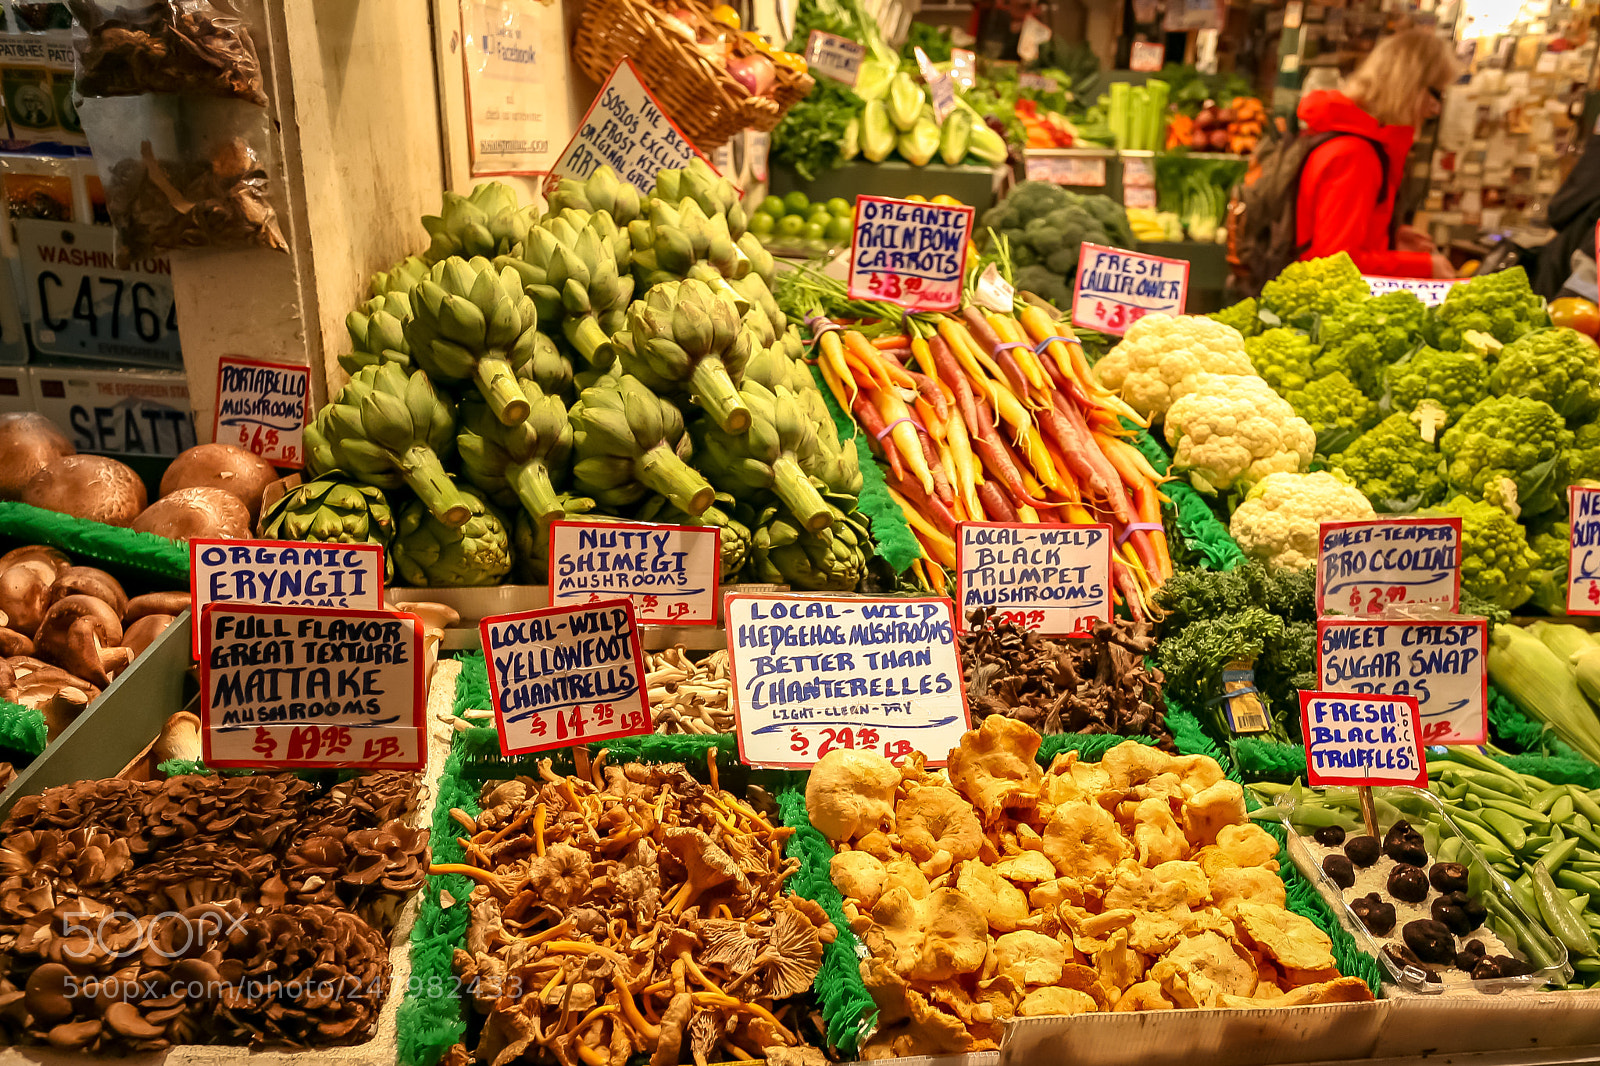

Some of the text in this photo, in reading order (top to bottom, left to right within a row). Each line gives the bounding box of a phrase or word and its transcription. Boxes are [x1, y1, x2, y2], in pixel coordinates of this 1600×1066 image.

[601, 119, 636, 155] FROST
[639, 96, 697, 160] THE BES
[580, 124, 625, 174] ORIGINAL
[639, 132, 686, 170] EXCLU
[864, 201, 965, 229] ORGANIC
[857, 222, 962, 252] RAINBOW
[857, 250, 959, 274] CARROTS
[1096, 253, 1163, 277] FRESH
[221, 365, 306, 398] PORTABELLO
[220, 398, 304, 420] MUSHROOMS
[201, 546, 363, 567] ORGANIC
[579, 529, 671, 555] NUTTY
[558, 552, 689, 576] SHIMEGI
[975, 547, 1061, 569] BLACK
[1323, 545, 1459, 586] BROCCOLINI
[210, 568, 367, 602] ERYNGII
[559, 572, 688, 590] MUSHROOMS
[963, 565, 1091, 588] TRUMPET
[964, 584, 1103, 606] MUSHROOMS
[215, 616, 402, 643] FULL FLAVOR
[739, 624, 846, 655] HEDGEHOG
[849, 620, 954, 645] MUSHROOMS
[1323, 626, 1477, 655] SWEET CRISP
[210, 640, 408, 669] GREAT TEXTURE
[496, 630, 632, 687] YELLOWFOOT
[747, 647, 931, 688] BETTER THAN
[1325, 648, 1479, 685] SUGAR SNAP
[500, 666, 635, 713] CHANTRELLS
[752, 673, 953, 710] CHANTERELLES
[222, 698, 381, 725] MUSHROOMS
[1314, 701, 1396, 724] FRESH
[1311, 747, 1410, 770] TRUFFLES
